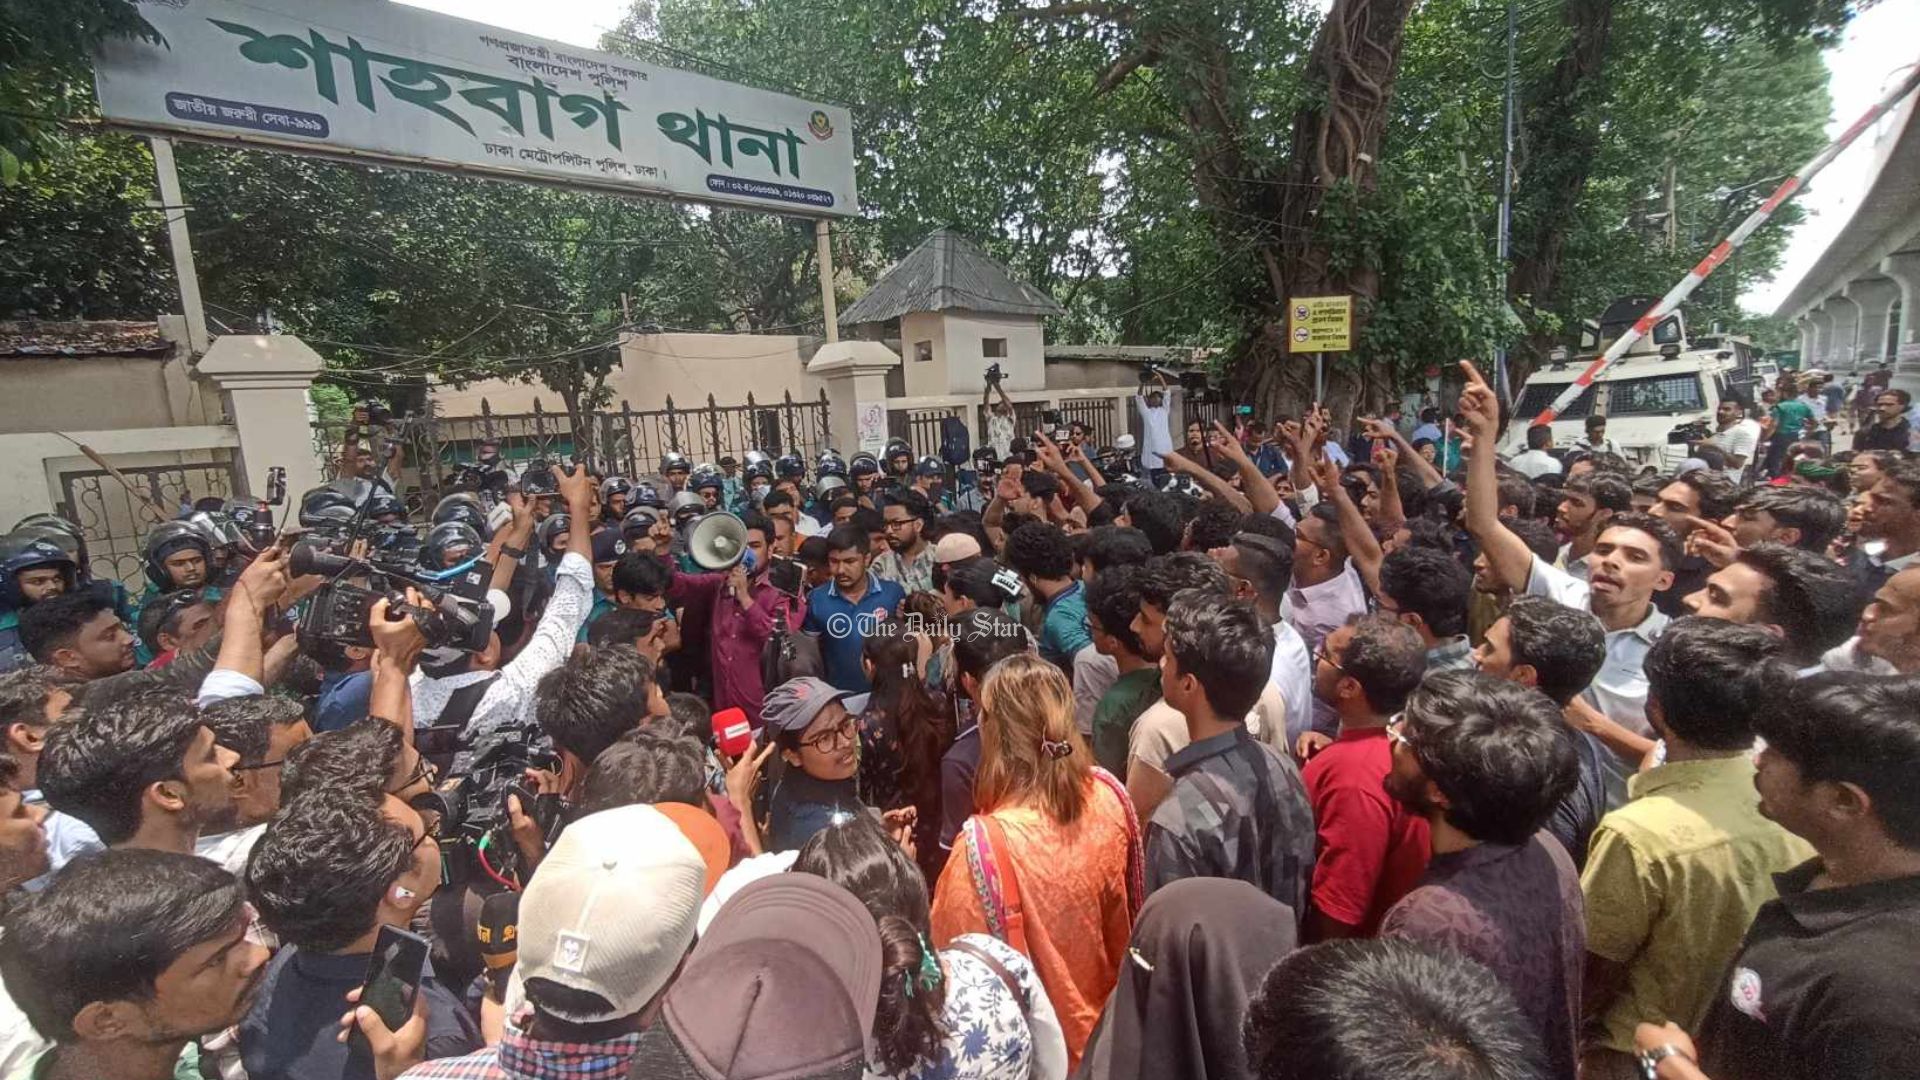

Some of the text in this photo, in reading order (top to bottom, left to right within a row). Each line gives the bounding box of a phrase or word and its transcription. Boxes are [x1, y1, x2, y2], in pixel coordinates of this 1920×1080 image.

[505, 54, 628, 91] বাংলাদেশ পুলিশ
[554, 51, 607, 72] বাংলাদেশ
[611, 65, 648, 81] সরকার
[173, 97, 217, 116] জাতীয়
[206, 17, 807, 179] শাহবাগ থানা
[482, 142, 514, 158] ঢাকা
[519, 148, 592, 169] মেট্রোপলিটন
[595, 157, 632, 176] পুলিশ,
[633, 163, 658, 177] ঢাকা
